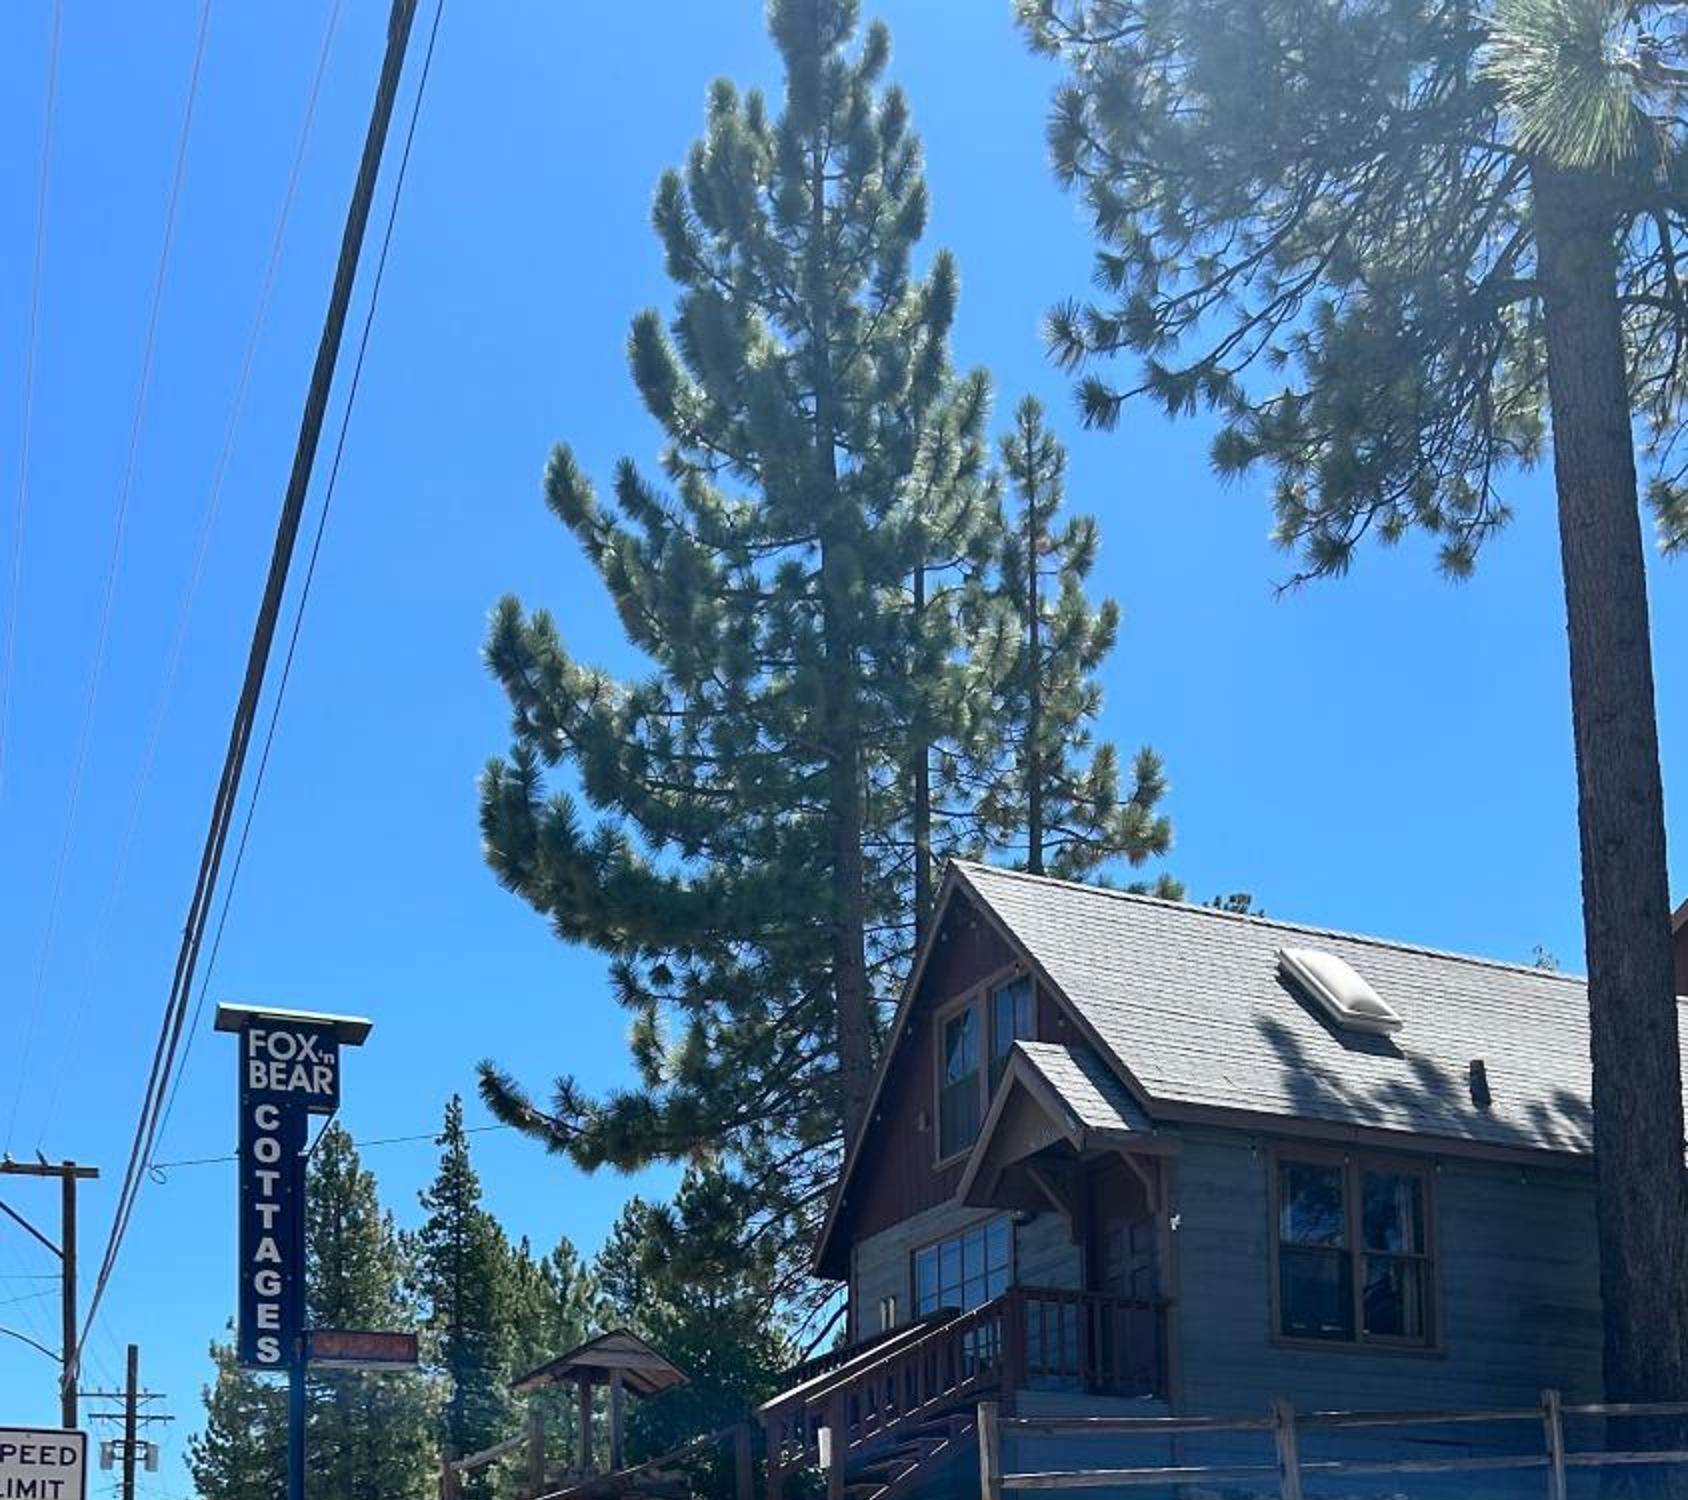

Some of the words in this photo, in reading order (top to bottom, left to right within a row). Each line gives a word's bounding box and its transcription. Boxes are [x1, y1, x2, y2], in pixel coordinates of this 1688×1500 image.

[248, 1029, 319, 1063] FOX
[248, 1059, 334, 1095] BEAR
[253, 1104, 282, 1364] COTTAGES
[0, 1443, 77, 1466] PEED
